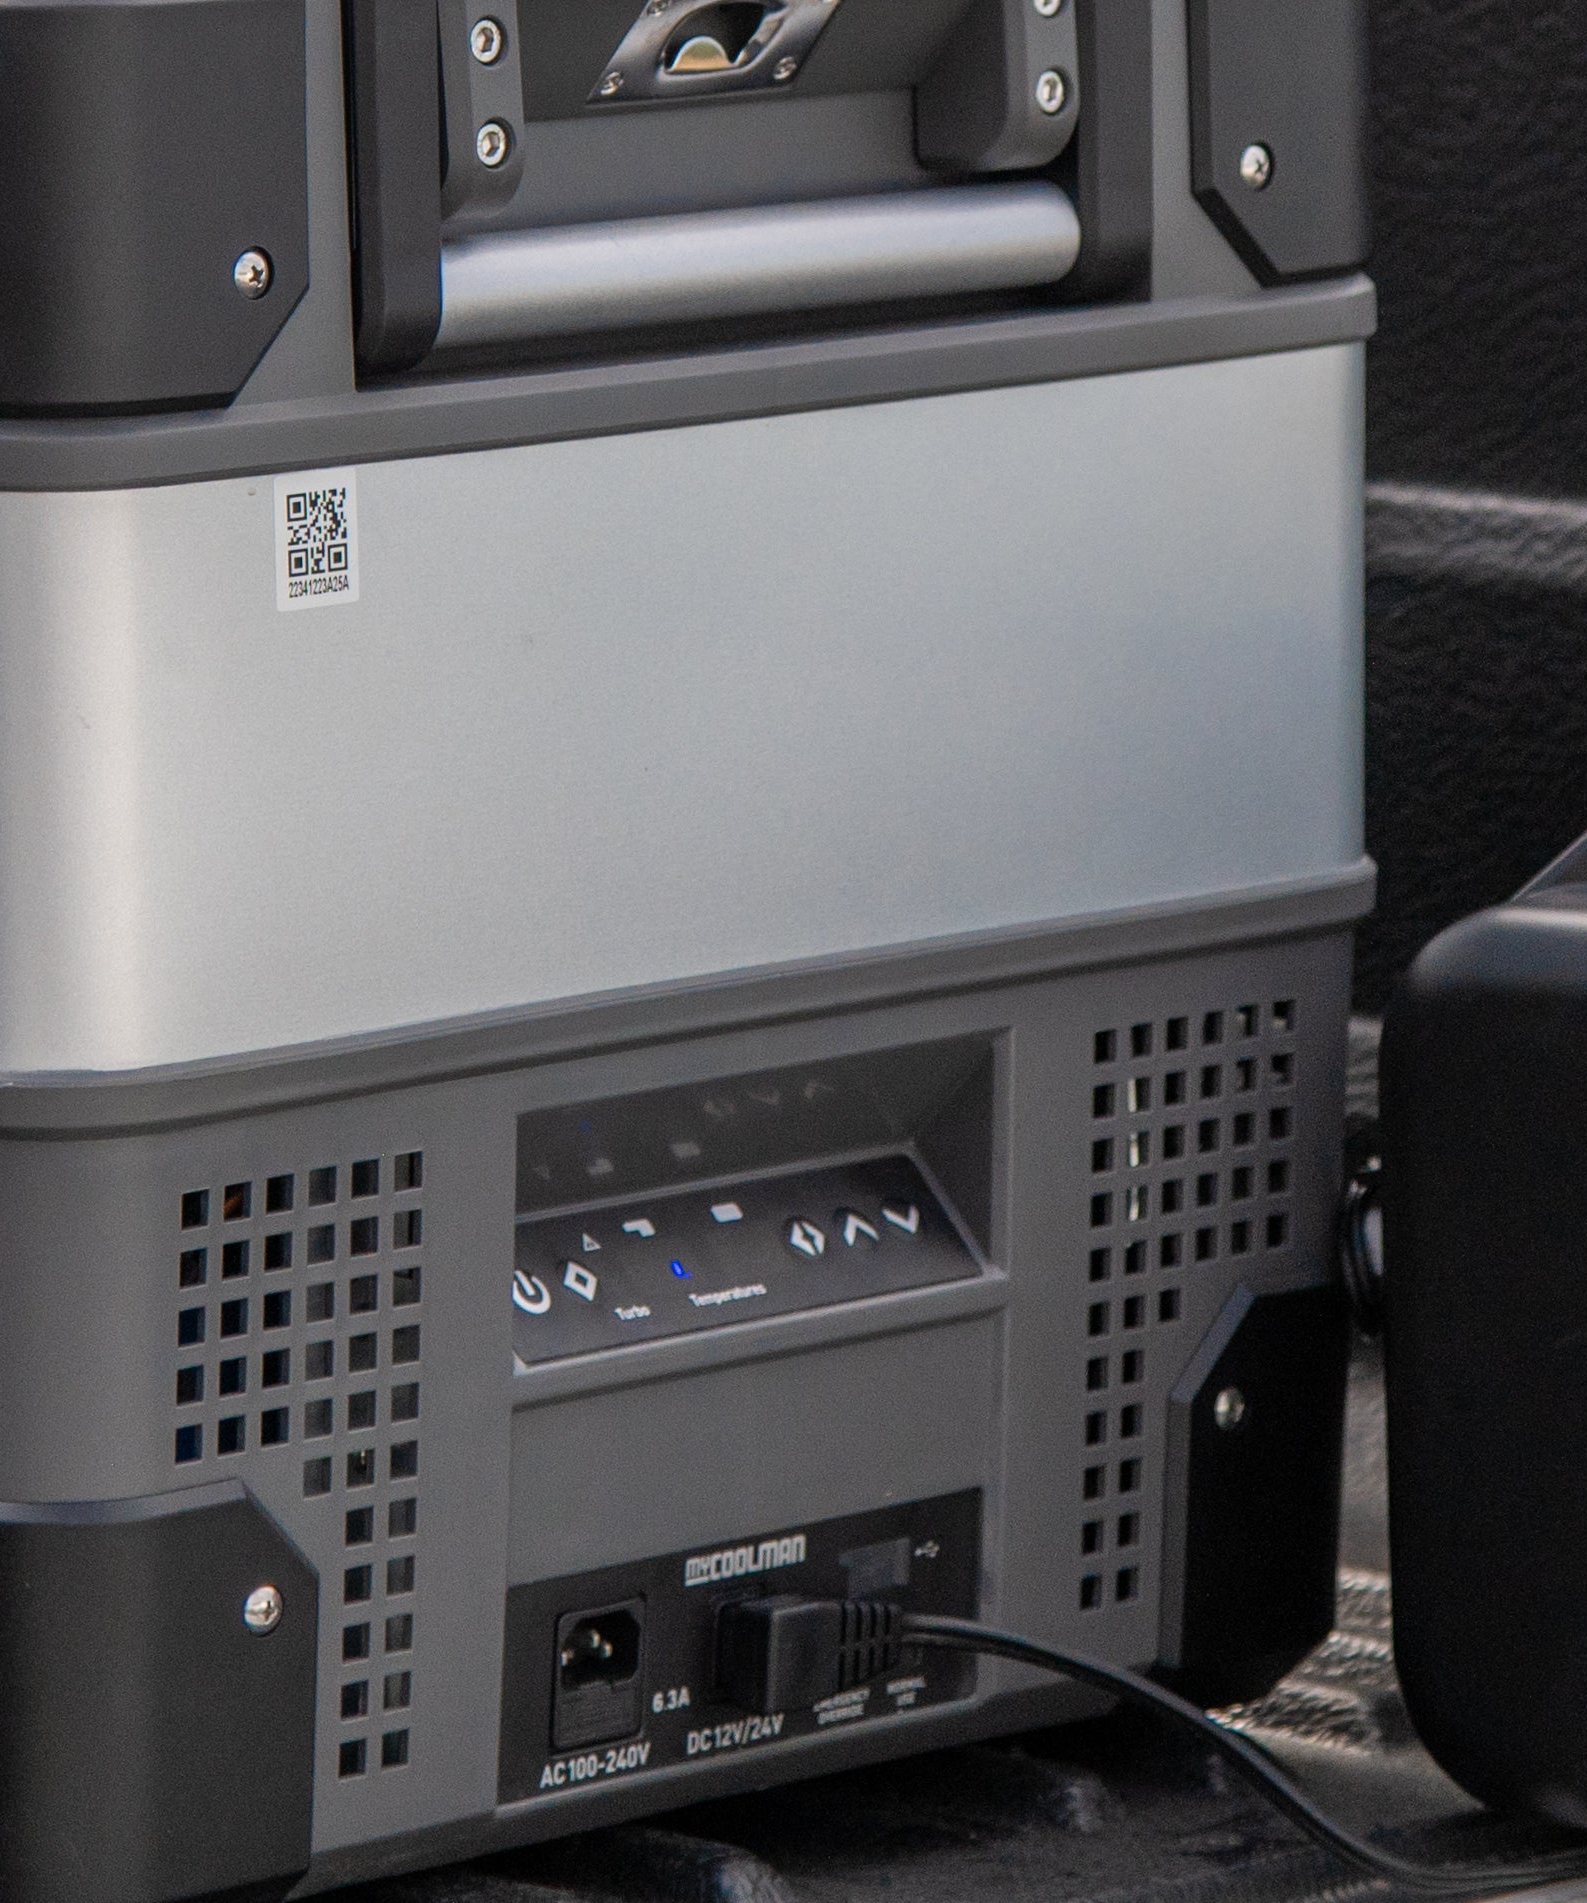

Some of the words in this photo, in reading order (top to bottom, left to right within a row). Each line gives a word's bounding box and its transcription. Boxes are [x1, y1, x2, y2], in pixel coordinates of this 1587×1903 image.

[288, 575, 350, 598] 22341223A25A
[614, 1304, 651, 1321] Turbo
[684, 1534, 806, 1587] MYCOOLMAN
[652, 1686, 691, 1714] 6.3A
